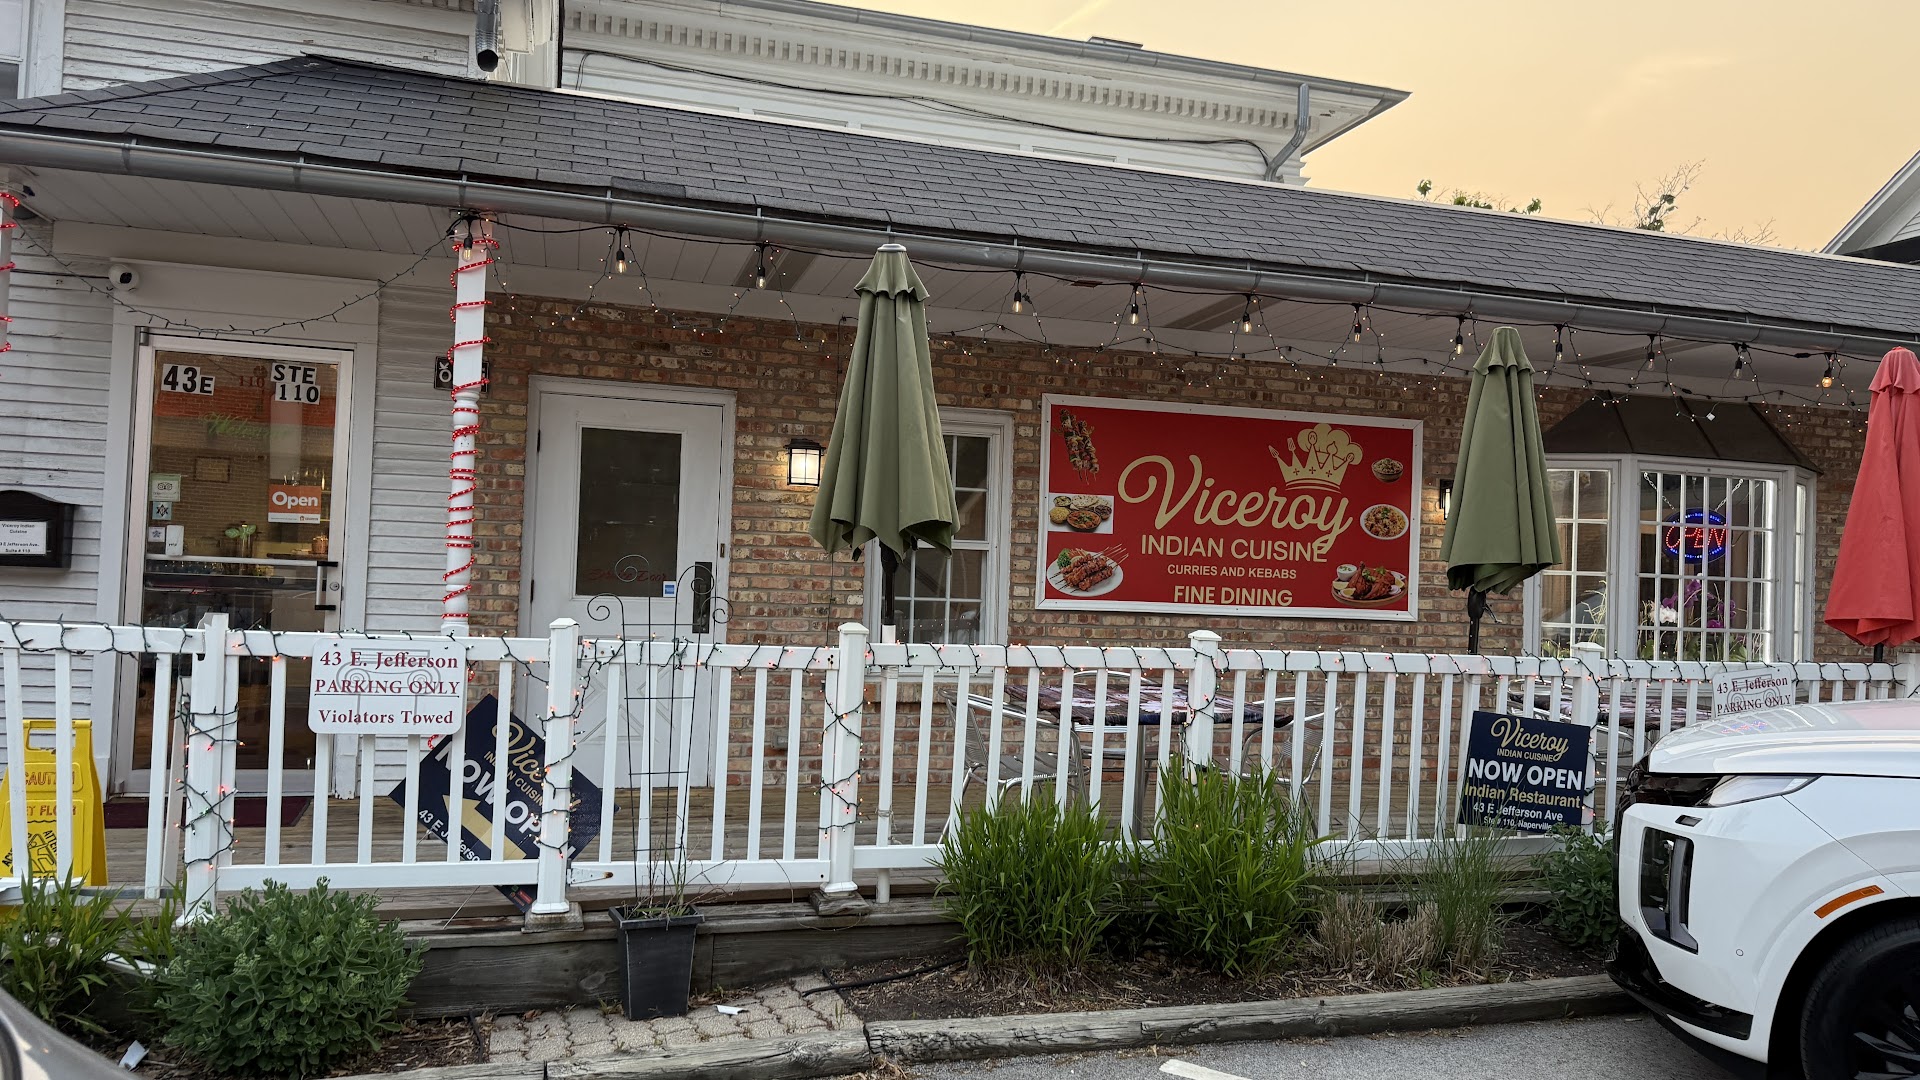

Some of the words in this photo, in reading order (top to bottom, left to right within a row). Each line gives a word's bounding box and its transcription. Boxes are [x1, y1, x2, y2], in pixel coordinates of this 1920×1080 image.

[273, 364, 316, 385] STE
[280, 384, 319, 403] 110
[272, 491, 318, 509] Open
[1118, 455, 1354, 554] Viceroy
[1141, 535, 1224, 559] INDIAN
[1231, 538, 1328, 563] CUISINE
[1167, 564, 1219, 578] CURRIES
[1220, 565, 1247, 578] AND
[1248, 567, 1297, 580] KEBABS
[1174, 585, 1215, 604] FINE
[1220, 586, 1293, 607] DINING
[320, 651, 342, 667] 43
[351, 652, 367, 667] E.
[375, 651, 458, 670] Jefferson
[315, 679, 402, 694] PARKING
[408, 680, 460, 695] ONLY
[1717, 682, 1728, 694] 43
[1745, 677, 1788, 693] Jefferson
[1717, 698, 1762, 714] PARKING
[1764, 694, 1791, 708] ONLY
[318, 709, 395, 725] Violators
[400, 710, 453, 725] Towed
[1490, 718, 1569, 762] Viceroy
[1497, 748, 1523, 759] INDIAN
[1524, 752, 1553, 762] CUISINE
[1468, 758, 1523, 783] NOW
[1527, 765, 1583, 790] OPEN
[1465, 783, 1505, 800] Indian
[1509, 788, 1580, 808] Restaurant
[419, 809, 434, 824] 43
[432, 819, 444, 832] E
[1545, 809, 1563, 821] Ave
